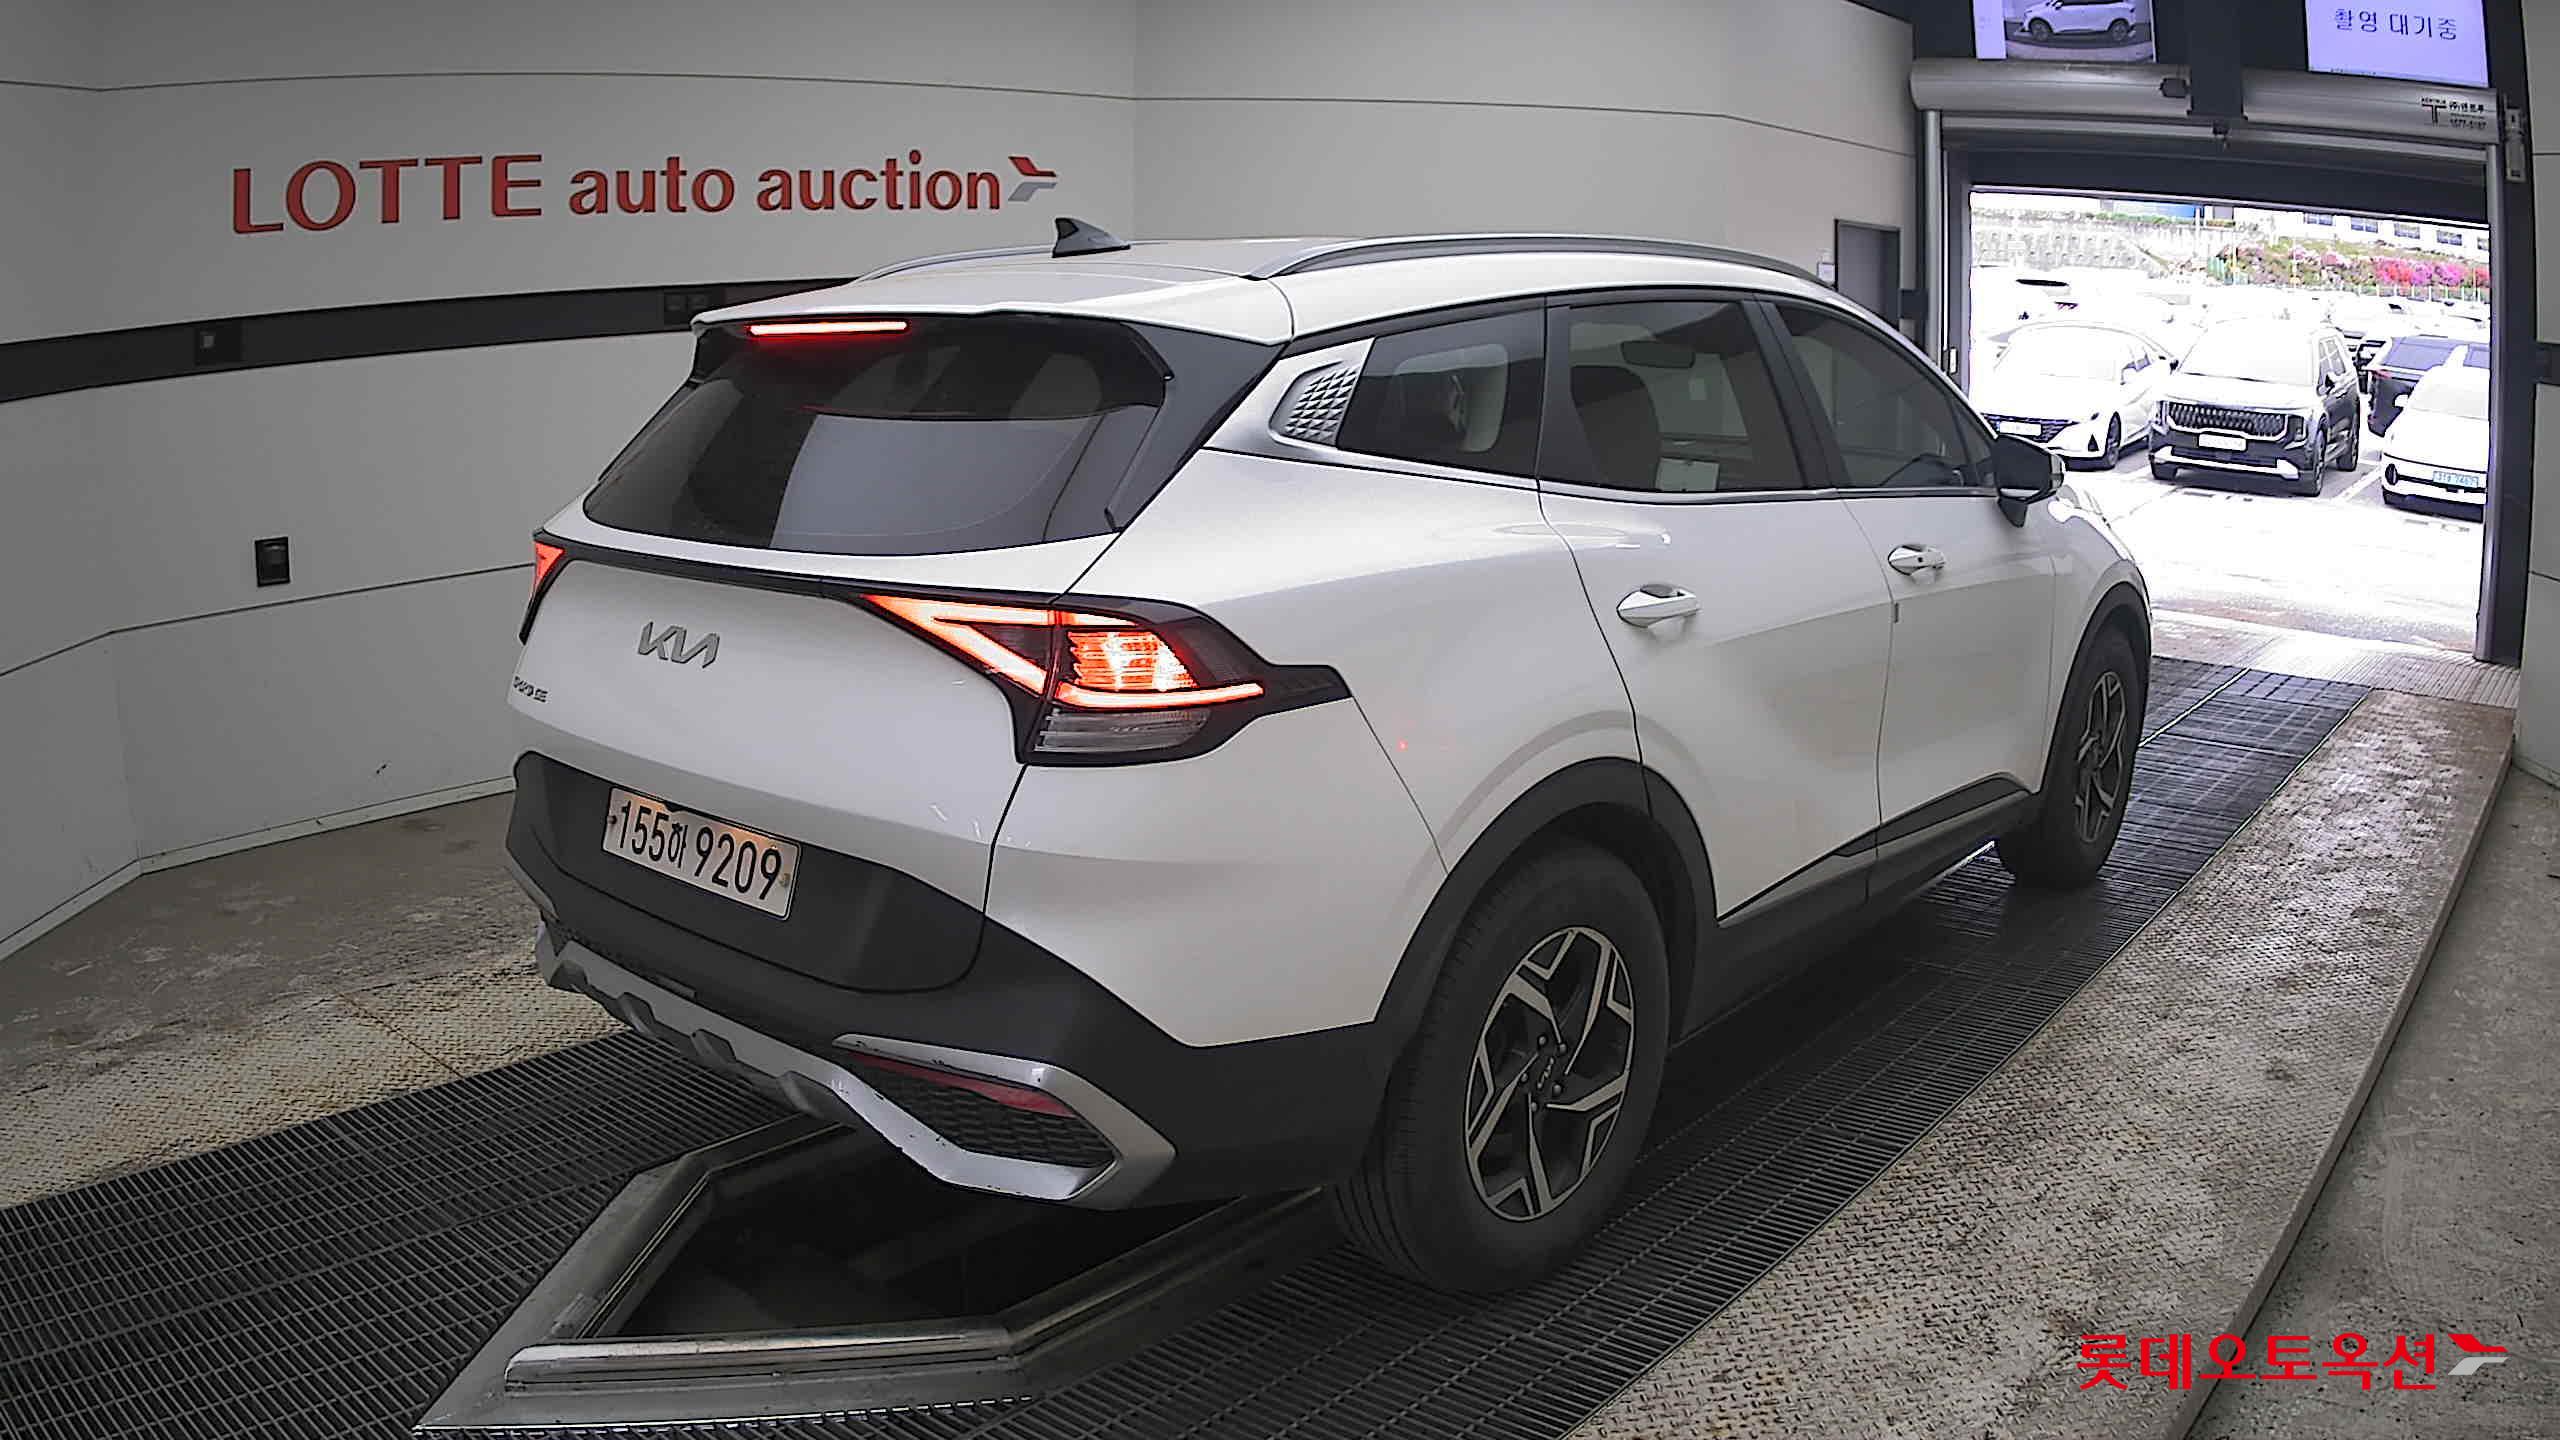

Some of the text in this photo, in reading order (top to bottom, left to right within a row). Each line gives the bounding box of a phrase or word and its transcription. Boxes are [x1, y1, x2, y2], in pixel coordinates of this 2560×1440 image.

[2335, 8, 2457, 41] 촬영 대기중
[232, 149, 1001, 235] LOTTE auto auction
[694, 826, 783, 900] 9209
